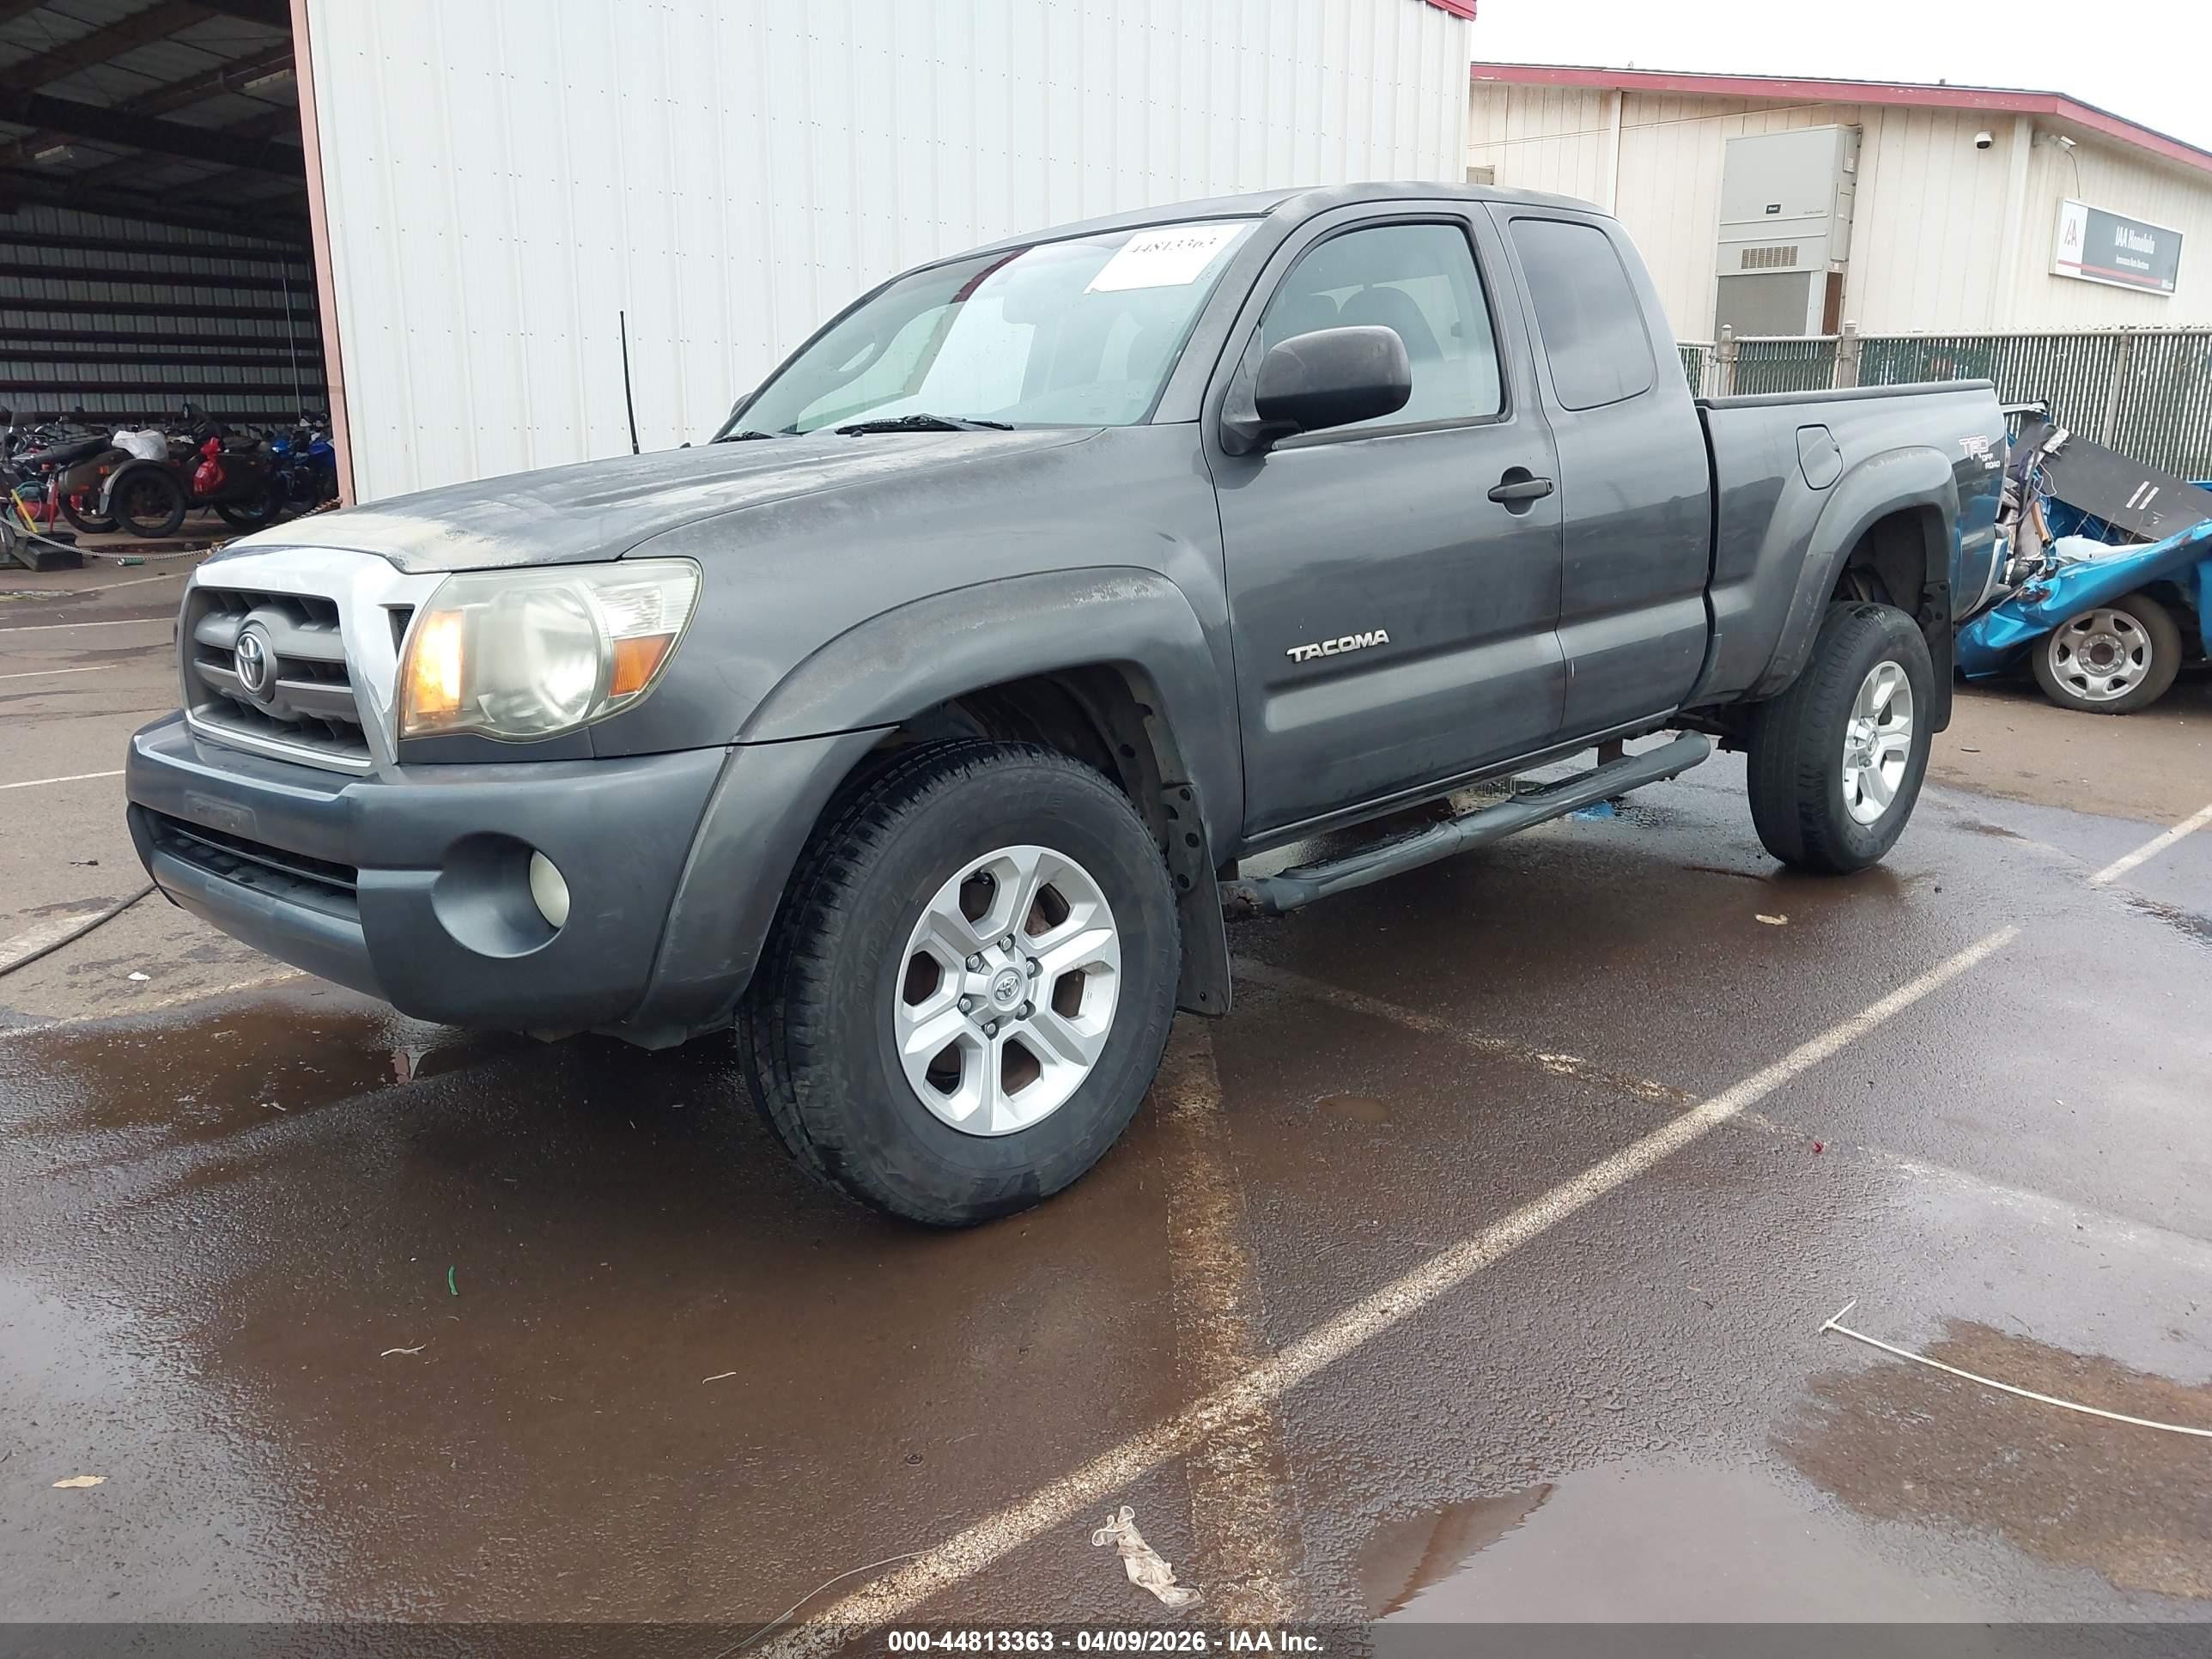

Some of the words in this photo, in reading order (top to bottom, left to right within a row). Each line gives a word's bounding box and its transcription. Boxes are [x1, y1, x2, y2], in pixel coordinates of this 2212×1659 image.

[1958, 434, 1989, 460] TRD
[1981, 453, 1994, 462] OFF
[1984, 460, 2001, 470] ROAD
[1286, 629, 1390, 662] TACOMA
